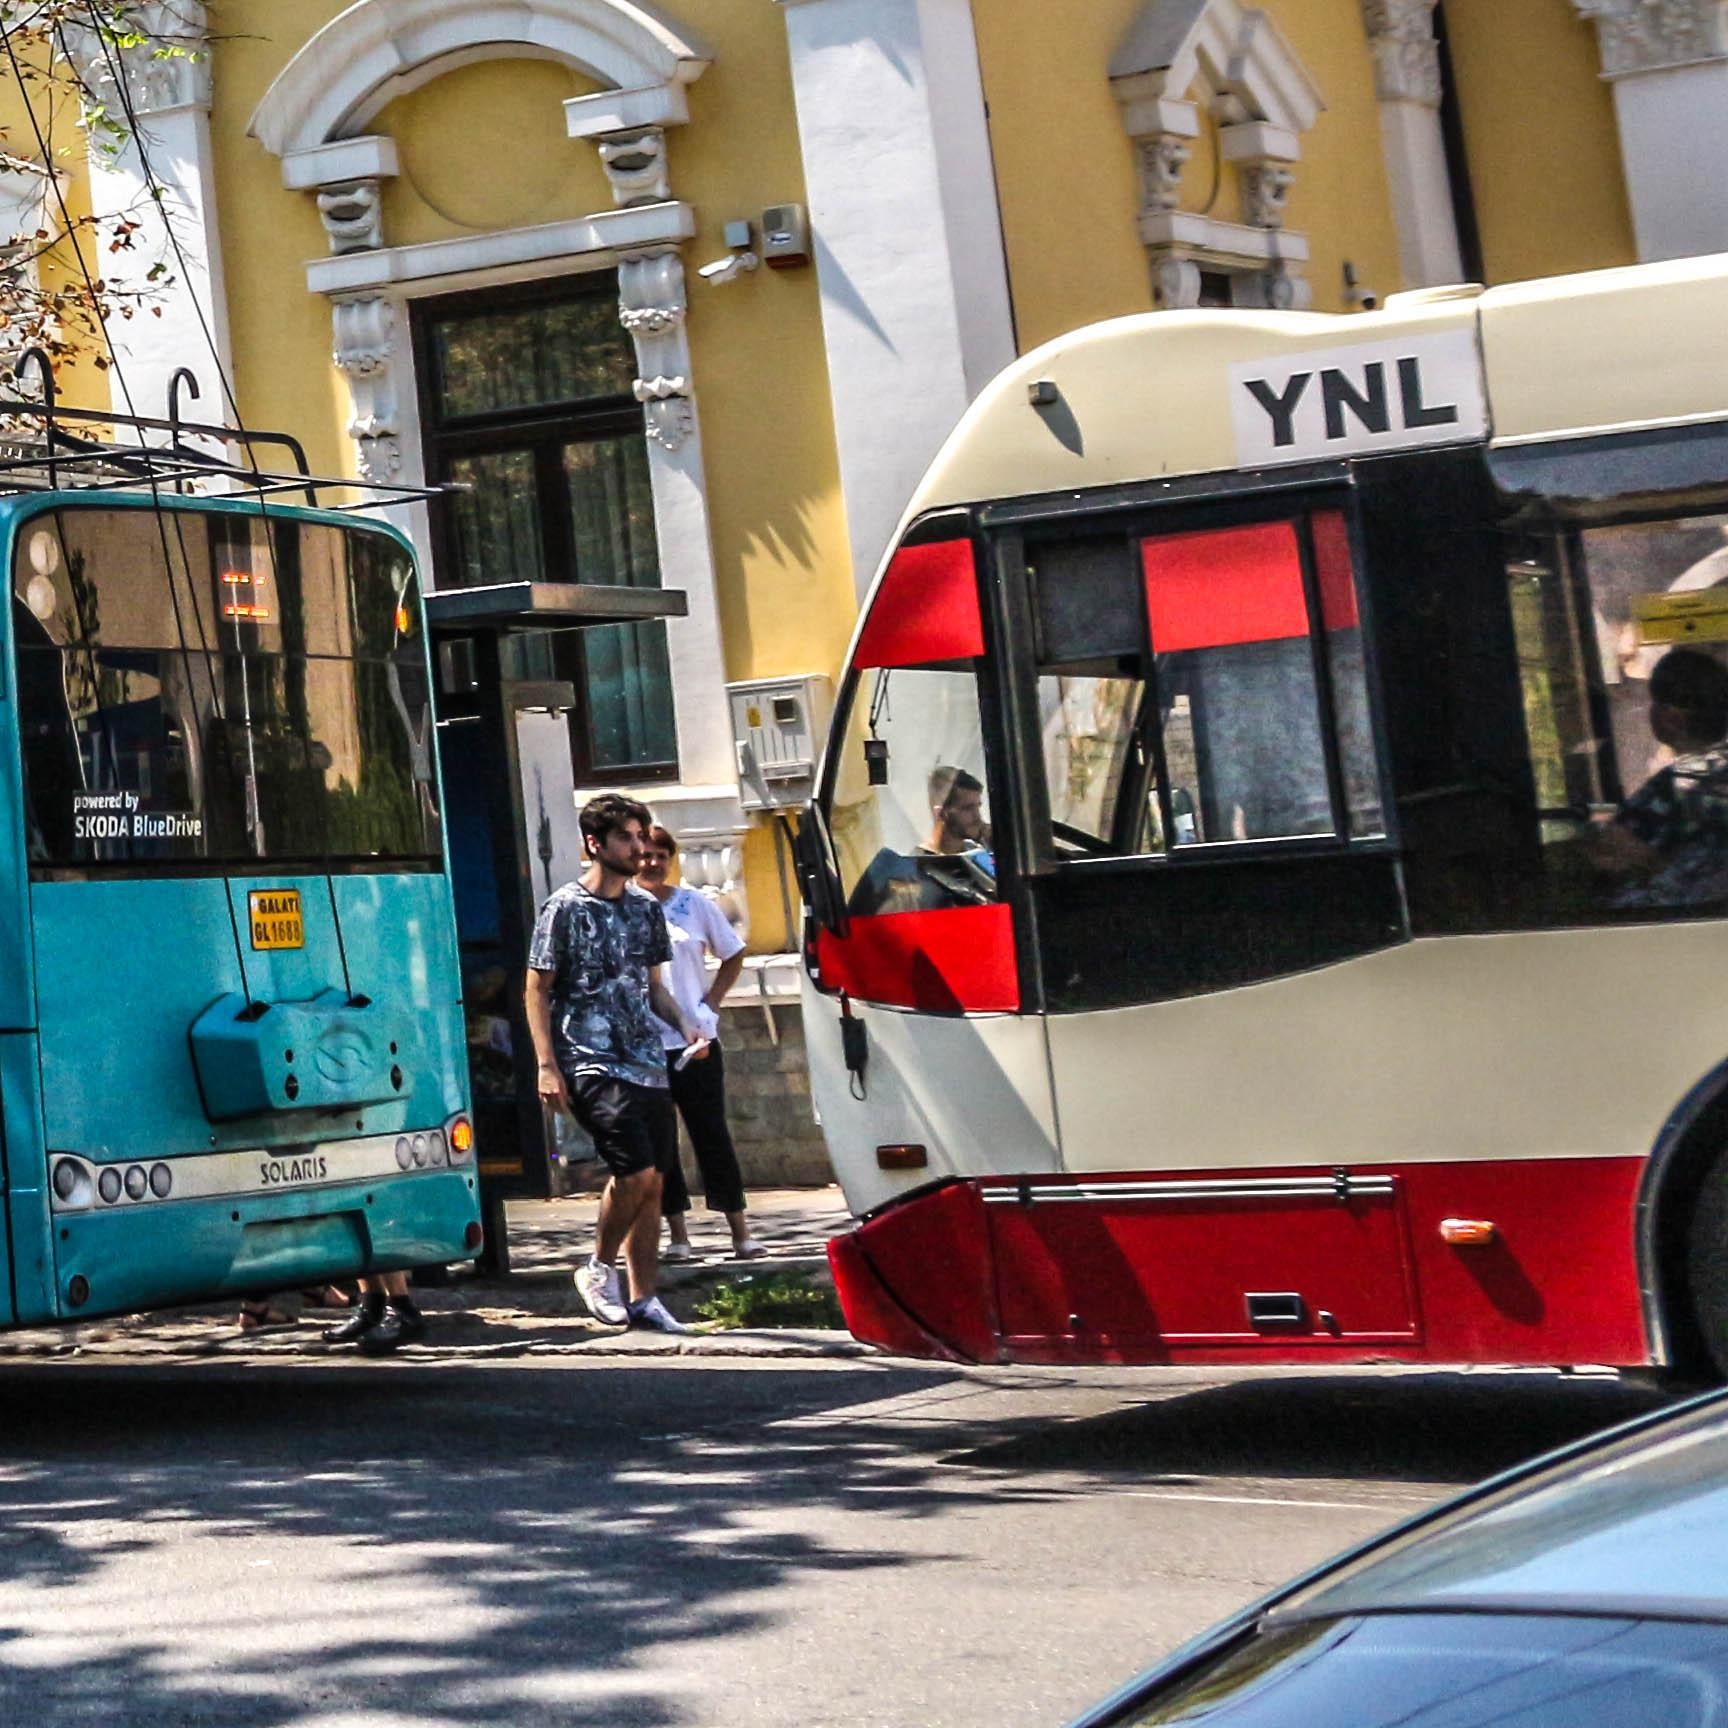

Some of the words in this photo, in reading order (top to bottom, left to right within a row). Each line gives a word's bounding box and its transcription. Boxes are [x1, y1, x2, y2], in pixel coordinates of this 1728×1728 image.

[1242, 356, 1458, 448] YNL
[73, 791, 123, 813] powered
[125, 791, 139, 812] by
[75, 815, 129, 838] SKODA
[133, 813, 202, 837] BlueDrive
[260, 1157, 327, 1184] SOLARIS
